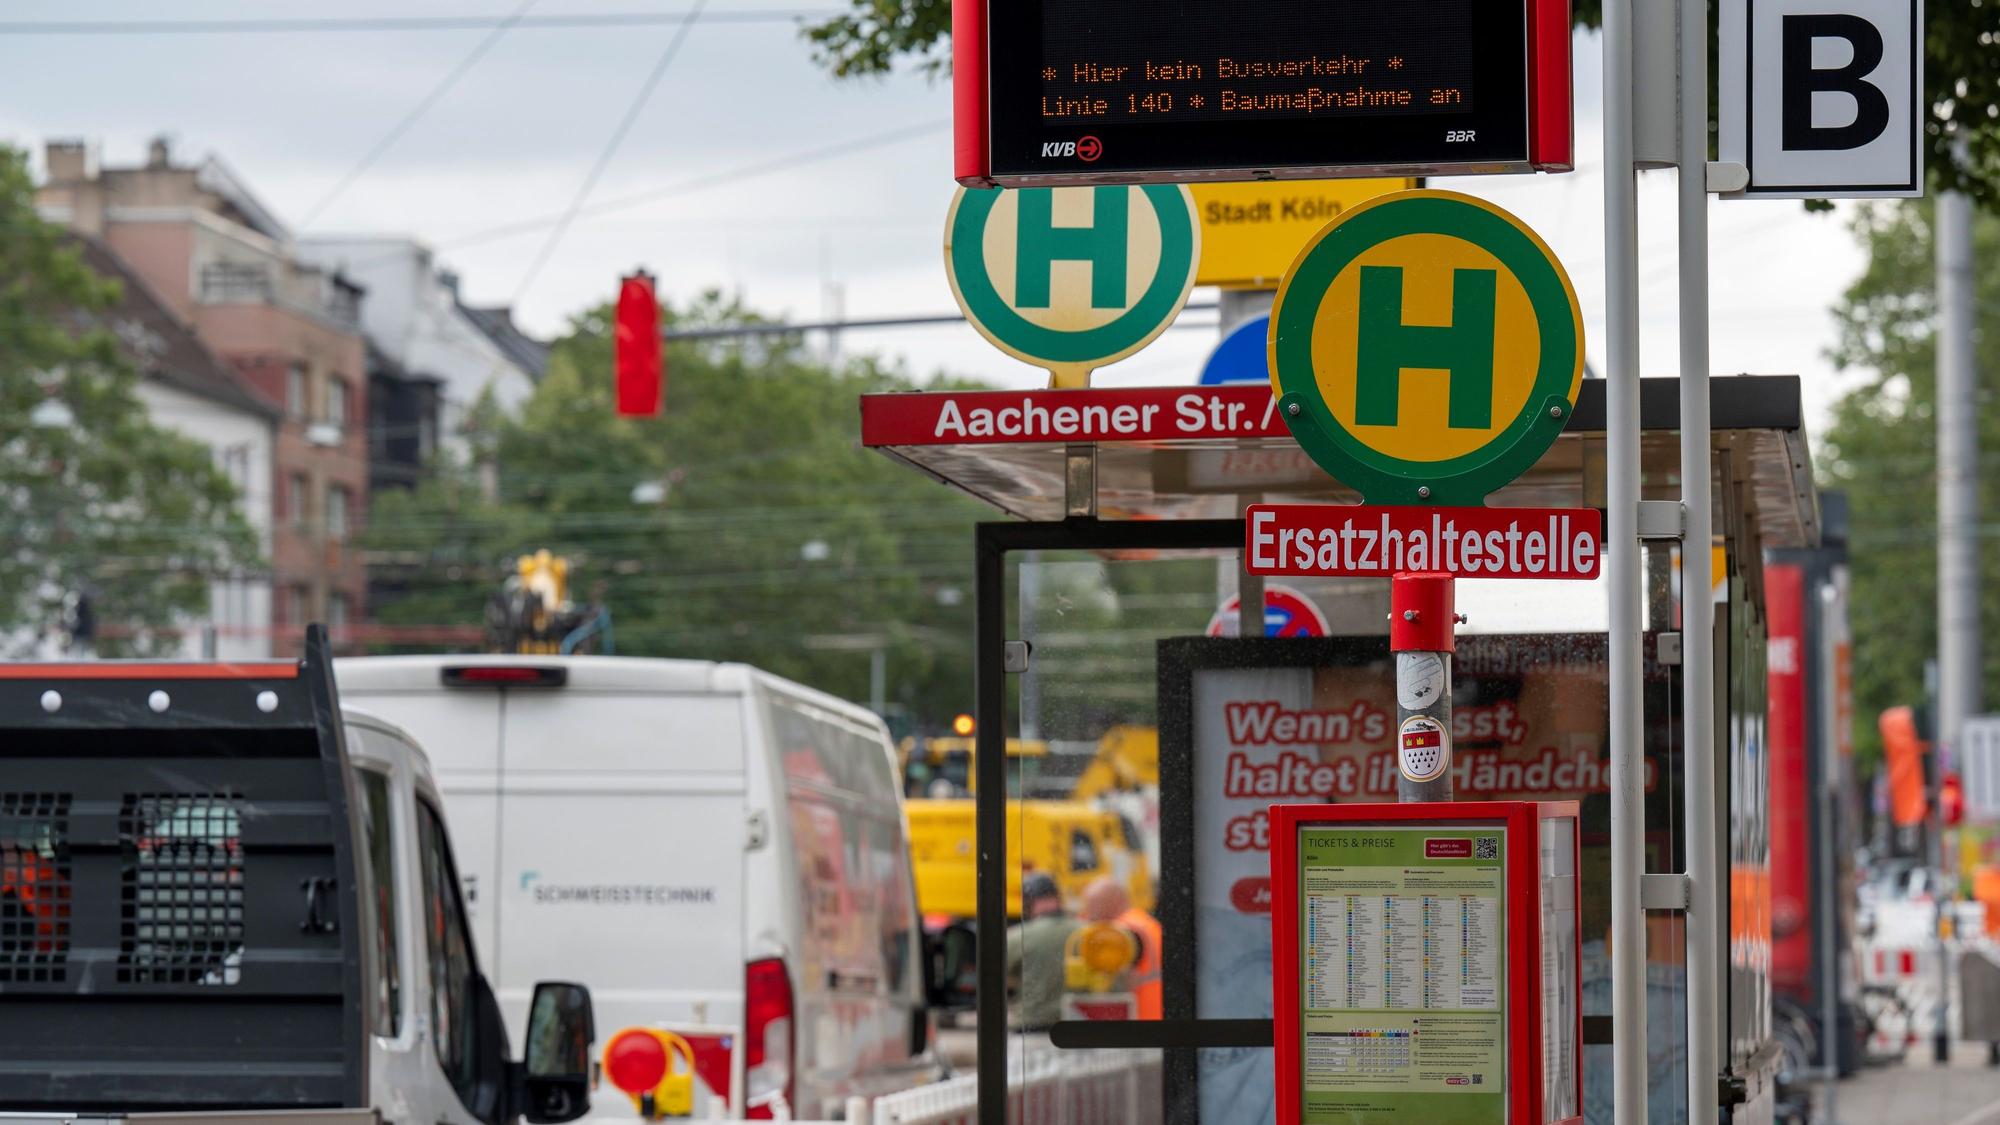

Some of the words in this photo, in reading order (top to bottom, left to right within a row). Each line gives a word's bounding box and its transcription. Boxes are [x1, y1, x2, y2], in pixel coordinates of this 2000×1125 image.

[1073, 62, 1129, 83] Hier
[1146, 60, 1202, 81] kein
[1218, 54, 1371, 79] Busverkehr
[1782, 13, 1890, 151] B
[1042, 95, 1108, 117] Linie
[1128, 92, 1173, 114] 140
[1221, 86, 1412, 113] Baumaßnahme
[1429, 88, 1462, 105] an
[1041, 141, 1076, 158] KVB
[1445, 130, 1476, 143] BBR
[1204, 199, 1273, 225] Stadt
[1280, 193, 1343, 222] Köln
[1014, 186, 1129, 309] H
[1354, 264, 1497, 430] H
[933, 397, 1160, 438] Aachener
[1251, 510, 1596, 574] Ersatzhaltestelle
[1452, 701, 1527, 744] sst,
[1228, 754, 1358, 795] haltet
[1308, 838, 1349, 848] TICKETS
[1351, 838, 1359, 848] &
[1362, 838, 1396, 848] PREISE
